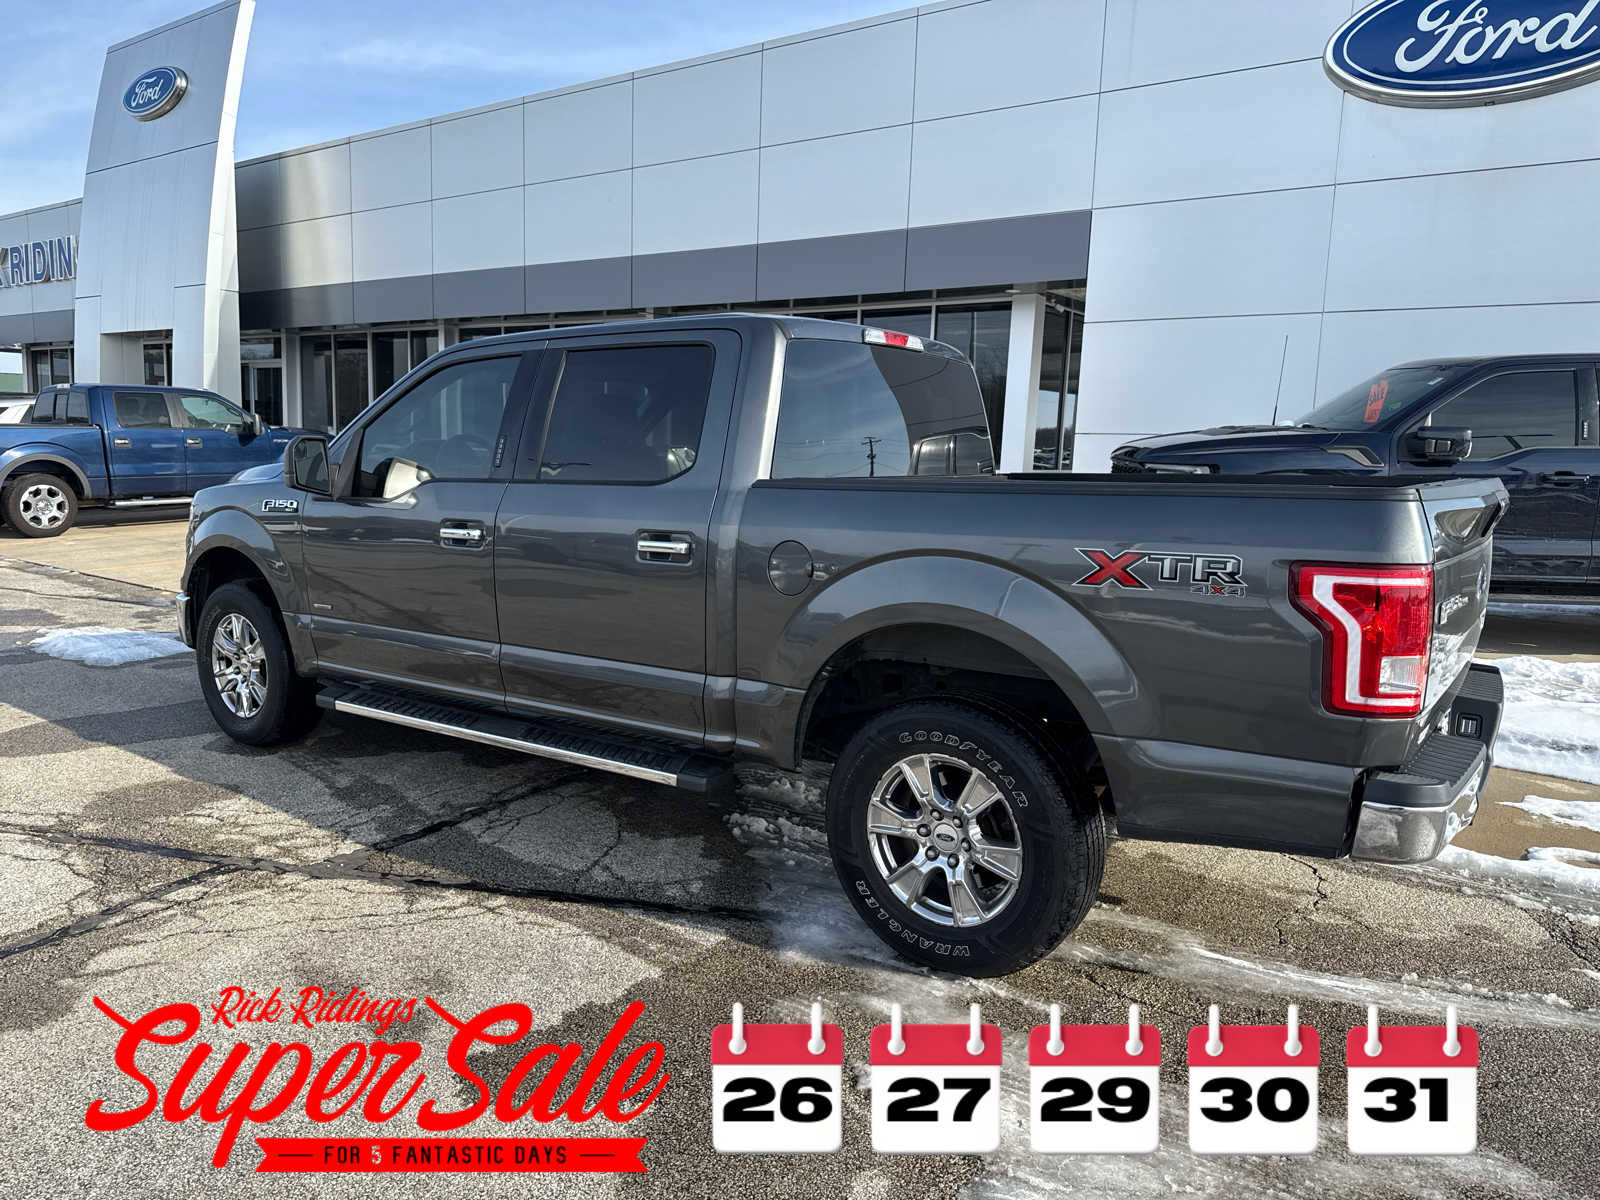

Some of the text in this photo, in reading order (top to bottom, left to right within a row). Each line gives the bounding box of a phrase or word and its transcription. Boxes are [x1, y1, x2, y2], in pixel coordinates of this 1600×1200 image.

[1394, 0, 1599, 73] Ford
[130, 76, 164, 108] Ford
[9, 235, 79, 286] RIDIN
[1072, 547, 1248, 591] XTR
[898, 730, 1029, 808] GOODYEAR
[855, 879, 971, 957] WRANGLER
